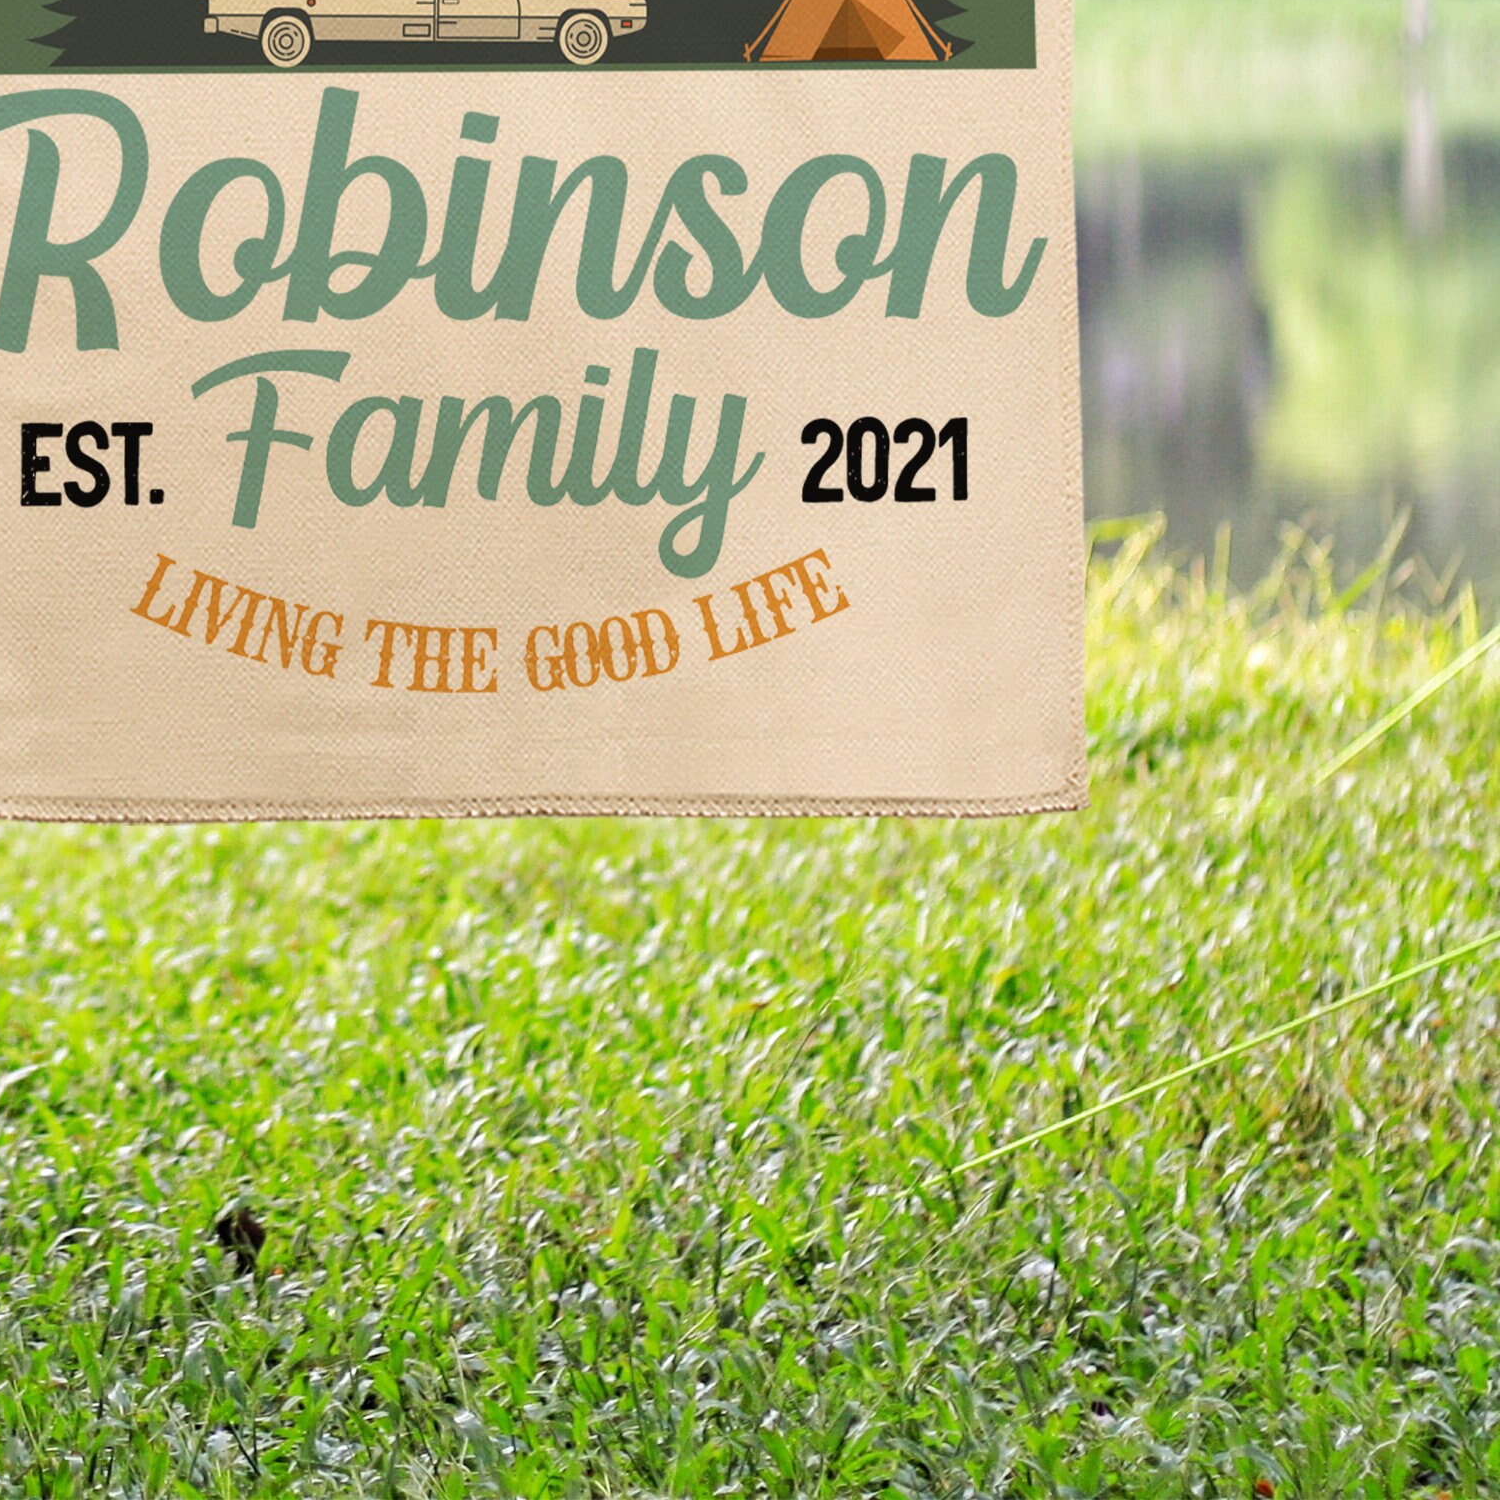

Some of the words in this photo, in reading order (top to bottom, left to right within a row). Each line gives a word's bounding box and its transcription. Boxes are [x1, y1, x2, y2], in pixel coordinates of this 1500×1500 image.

[20, 420, 165, 509] EST.
[191, 347, 764, 579] Family
[800, 416, 969, 504] 2021
[129, 551, 345, 681] LIVING
[363, 618, 499, 694] THE
[522, 608, 681, 693] GOOD
[691, 547, 851, 662] LIFE
